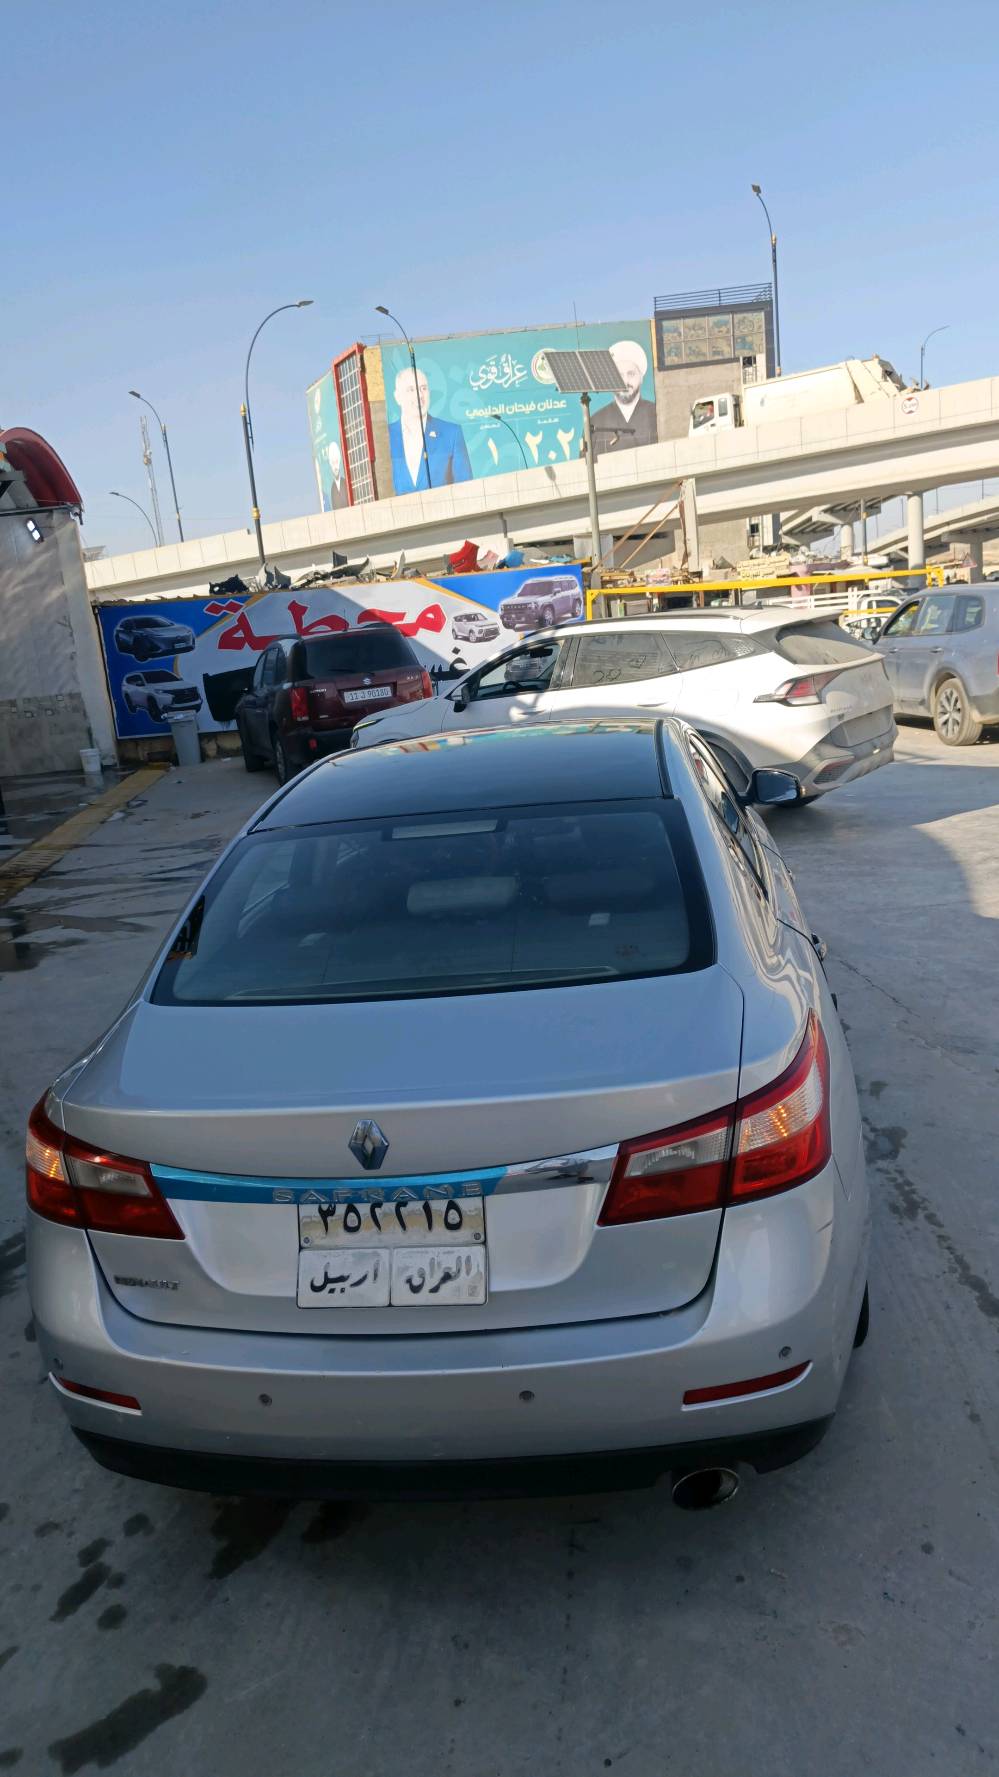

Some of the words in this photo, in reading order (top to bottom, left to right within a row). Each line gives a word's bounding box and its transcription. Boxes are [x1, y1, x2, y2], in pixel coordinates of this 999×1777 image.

[465, 403, 505, 420] الدليمي
[506, 401, 536, 415] فيحان
[537, 399, 567, 412] عدنان
[204, 599, 447, 651] محطة
[272, 1181, 484, 1203] SAFRANE
[309, 1259, 380, 1294] اربيل
[406, 1254, 472, 1294] العراق
